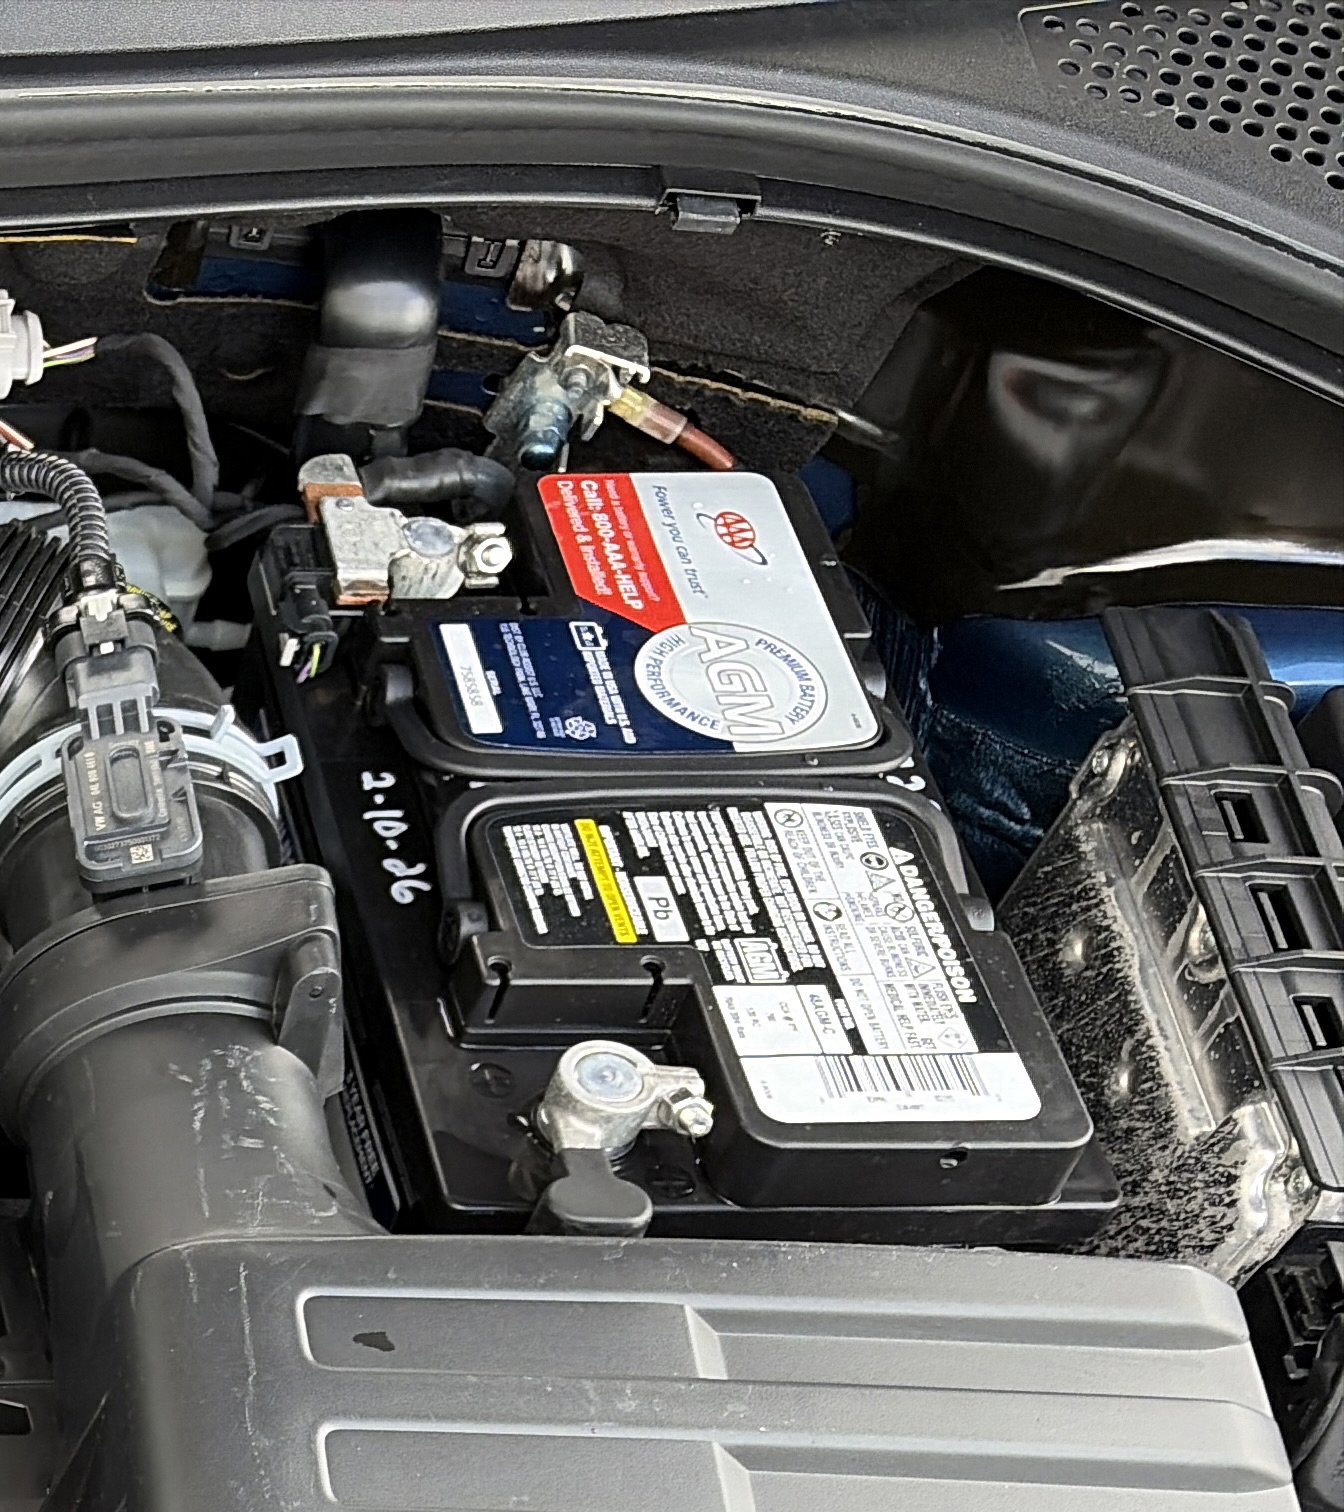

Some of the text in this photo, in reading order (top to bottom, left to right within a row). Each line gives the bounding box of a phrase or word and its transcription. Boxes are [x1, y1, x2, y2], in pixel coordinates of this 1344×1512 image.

[554, 480, 592, 532] Delivered
[573, 533, 594, 543] &
[577, 479, 645, 609] Call: 800-AAA-HELP
[661, 522, 683, 542] you
[674, 546, 692, 564] can
[714, 511, 756, 549] AAA
[578, 545, 613, 595] Installed!
[646, 634, 721, 730] HIGH PERFORMANCE
[688, 626, 785, 735] AGM
[755, 639, 815, 725] PREMIUM BATTERY
[91, 800, 104, 815] AG
[93, 815, 107, 831] VW
[646, 897, 677, 920] Pb
[897, 864, 978, 1003] DANGER/POISON
[737, 941, 784, 979] AGM
